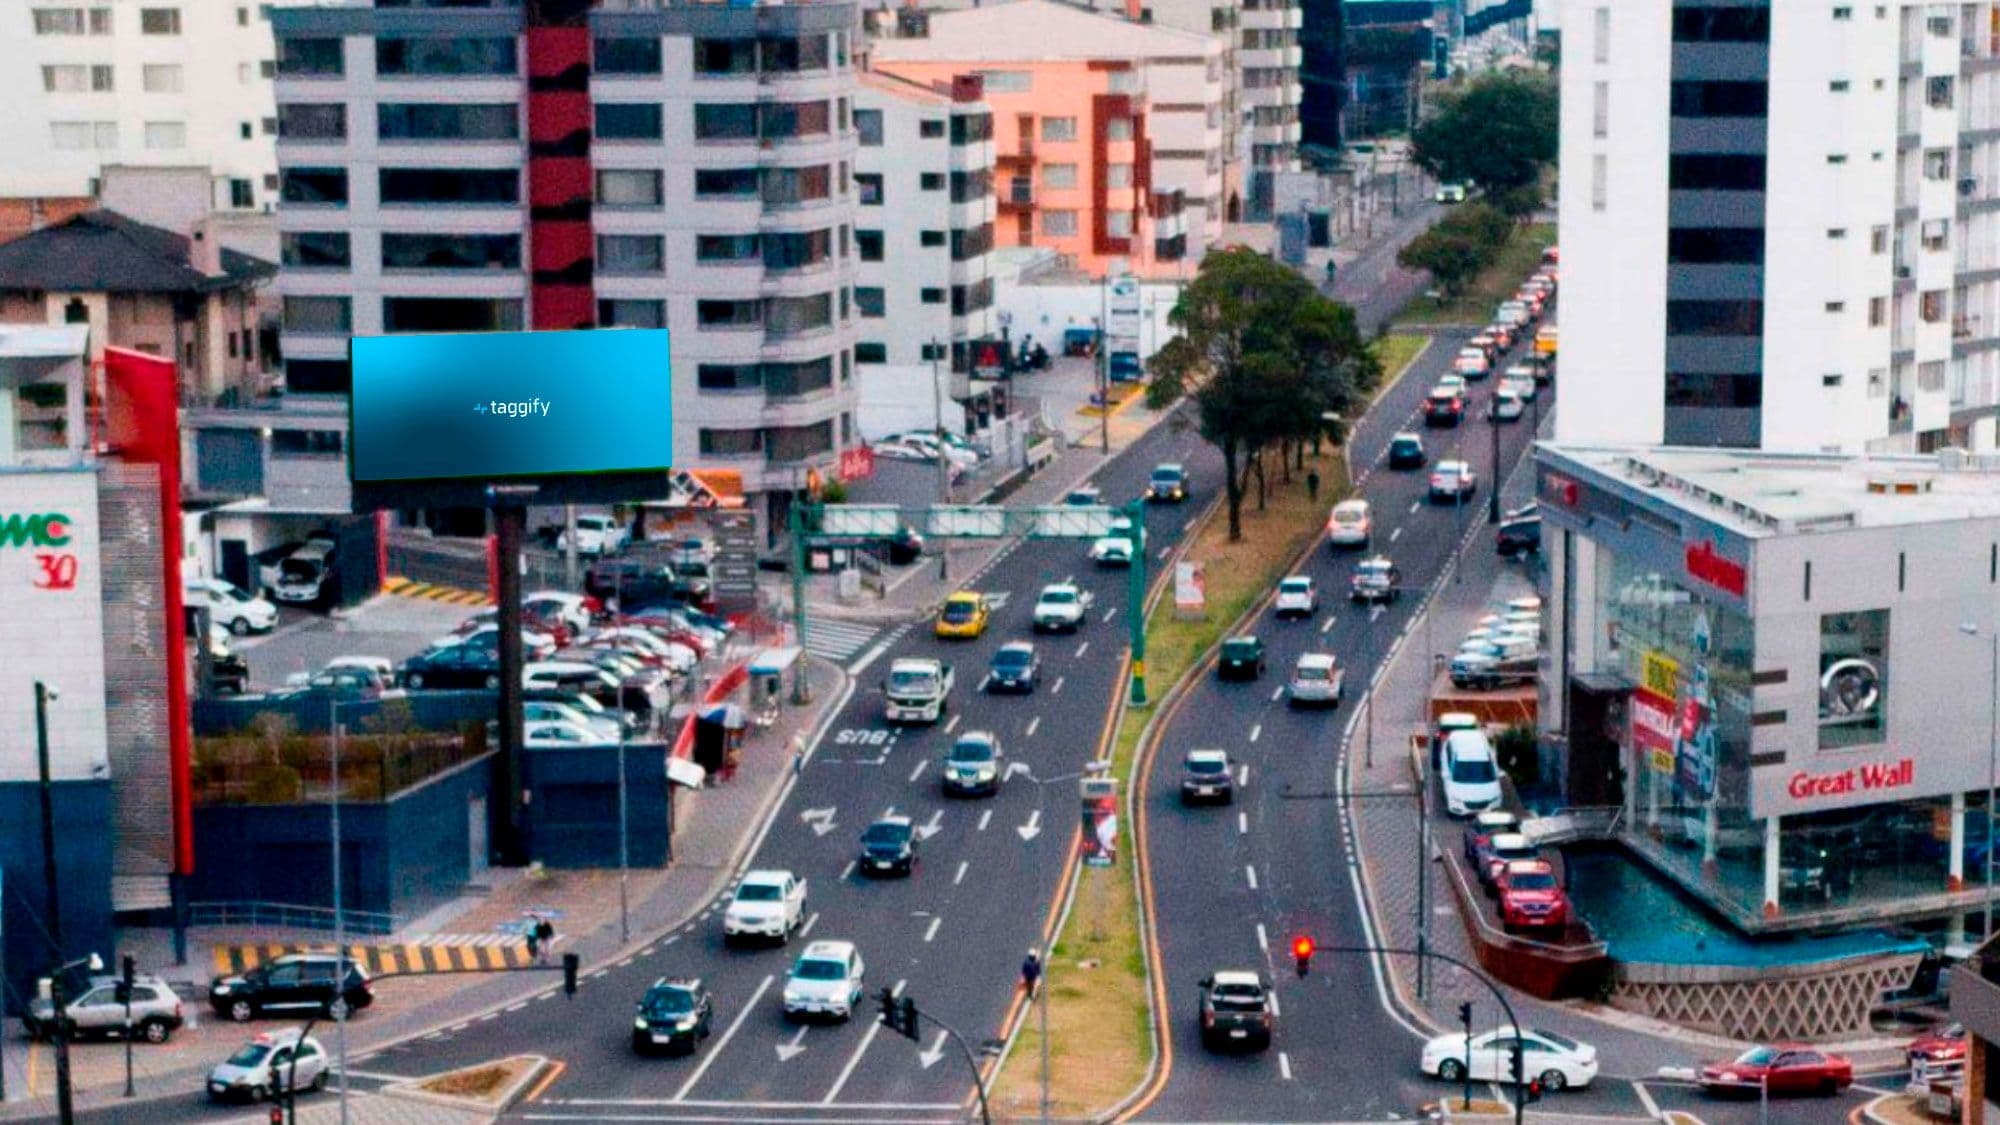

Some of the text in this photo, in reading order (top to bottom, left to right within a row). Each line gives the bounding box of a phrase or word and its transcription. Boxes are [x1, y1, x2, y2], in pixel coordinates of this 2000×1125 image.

[490, 398, 550, 417] taggify
[835, 729, 889, 745] BUS
[1788, 759, 1913, 799] Great Wall
